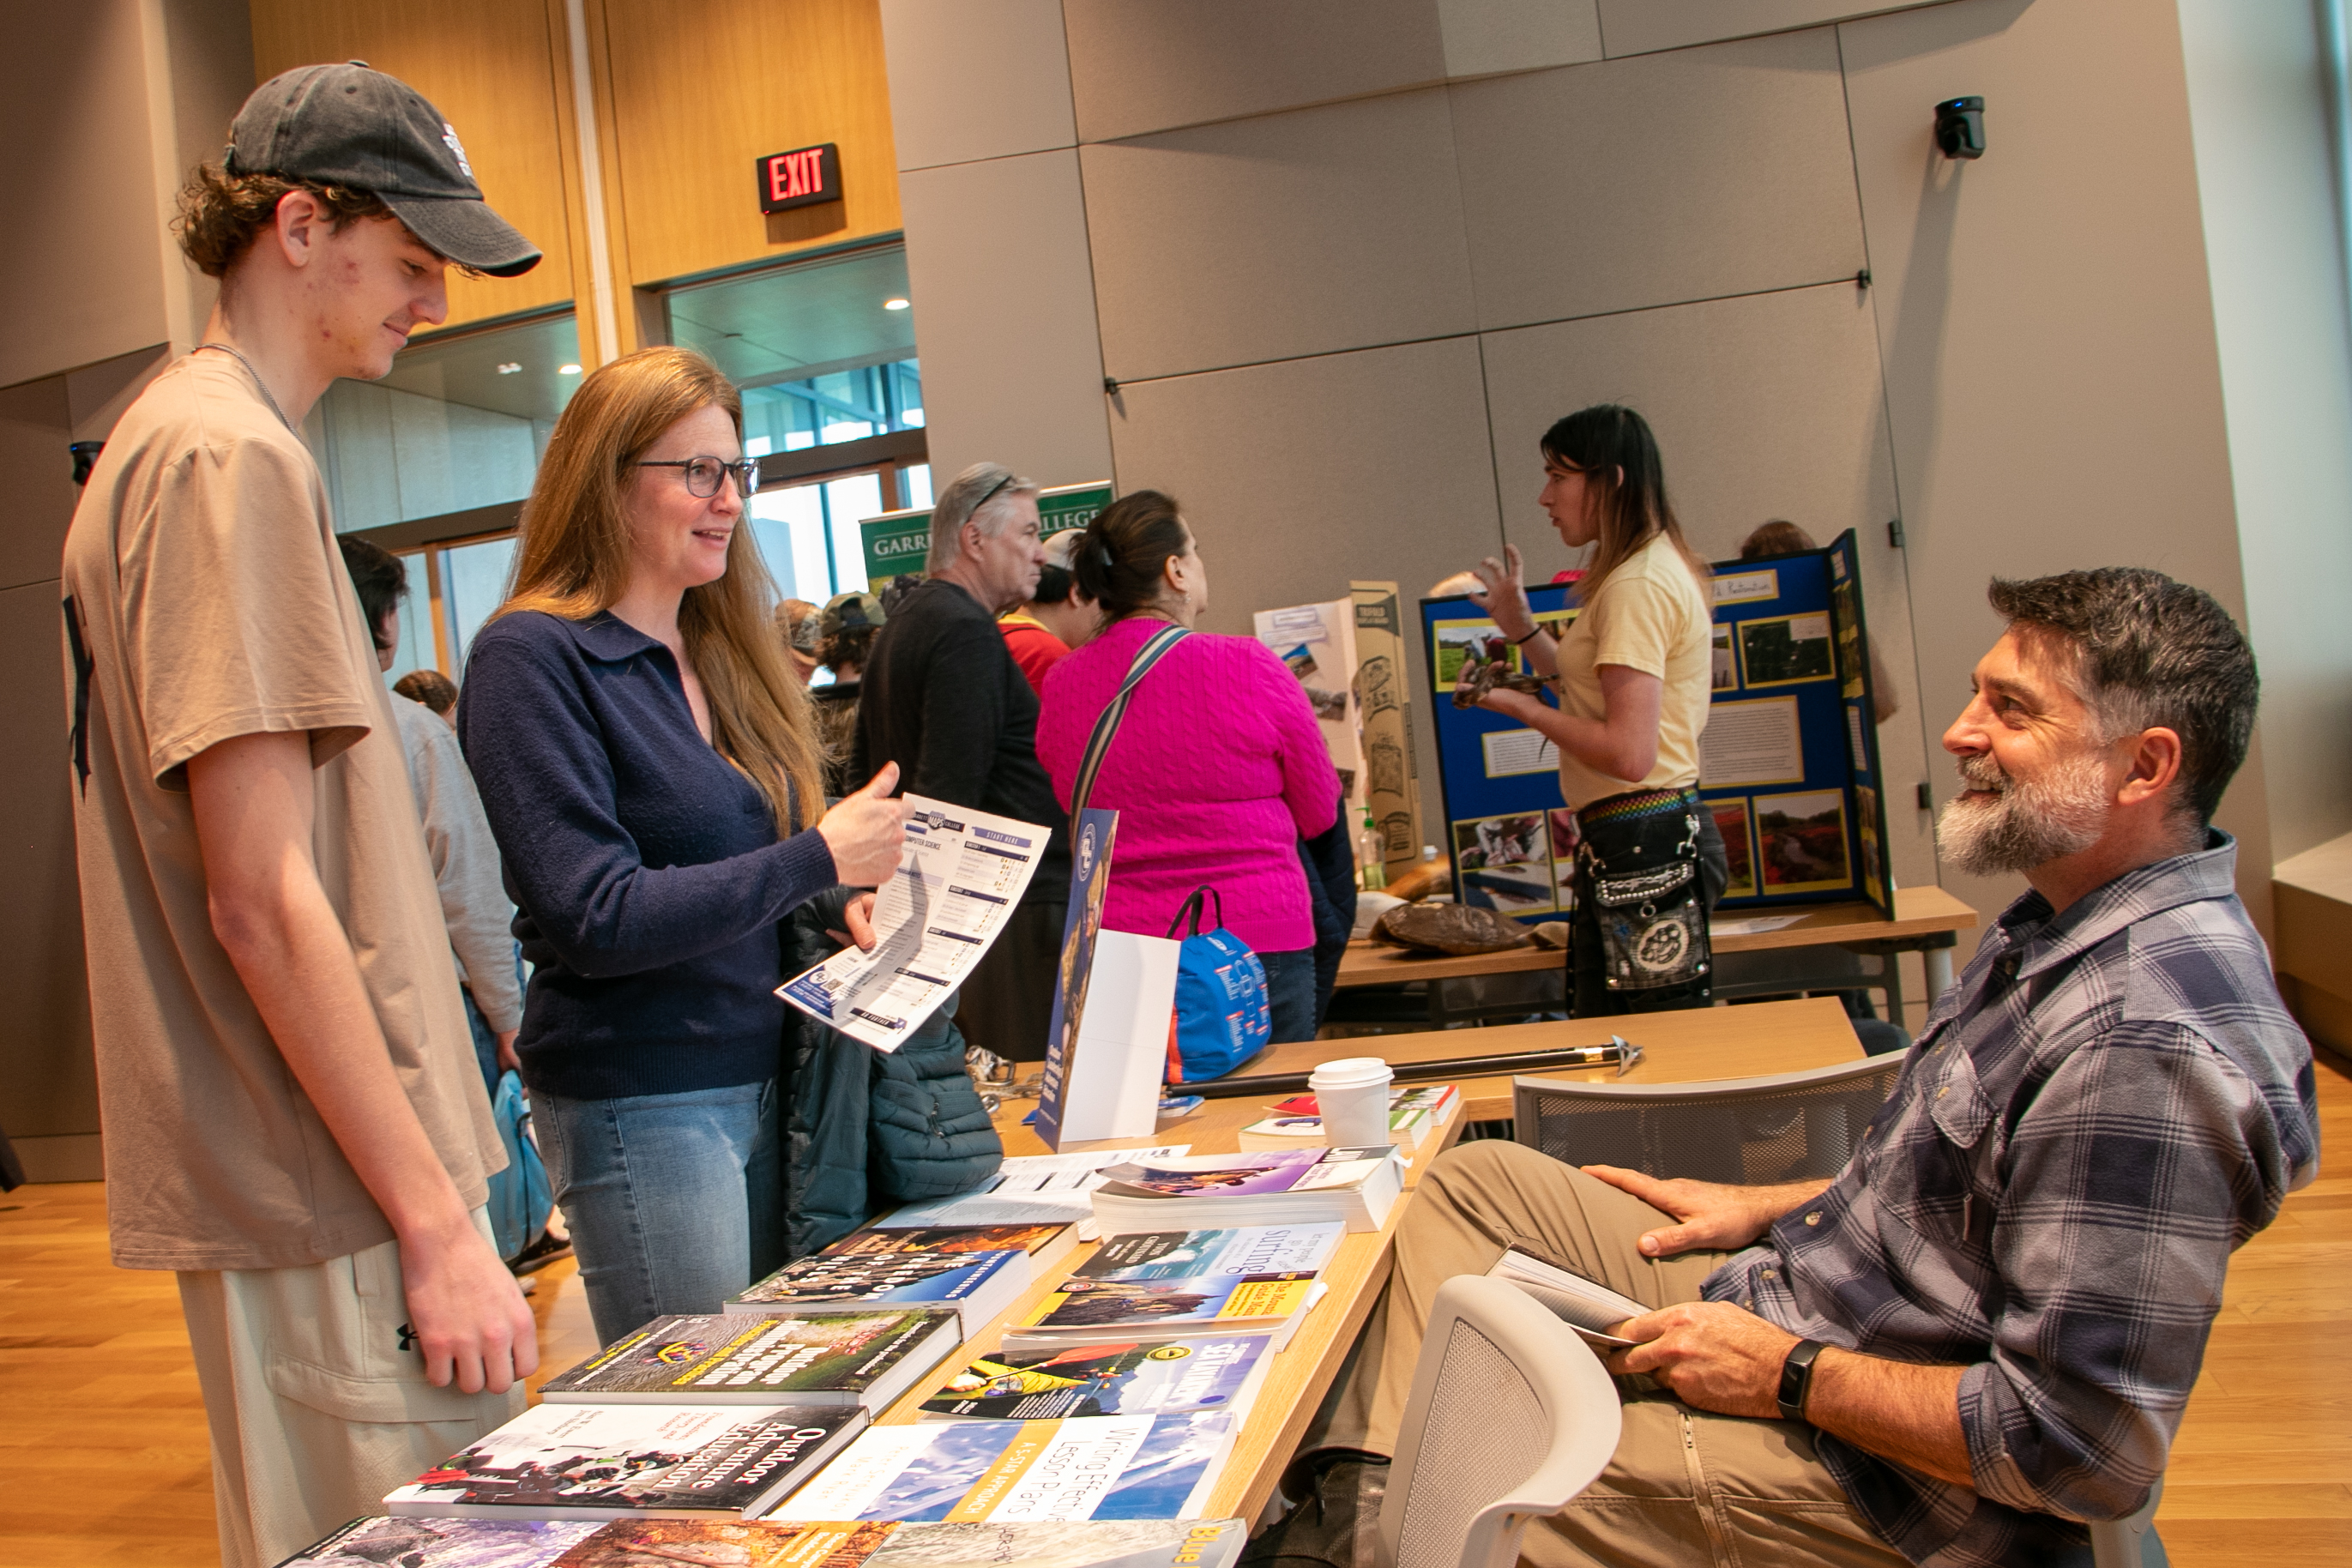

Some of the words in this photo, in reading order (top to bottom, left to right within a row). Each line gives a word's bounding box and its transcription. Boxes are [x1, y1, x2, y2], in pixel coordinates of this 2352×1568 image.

[770, 148, 823, 201] EXIT
[874, 533, 932, 555] GARR
[1041, 509, 1100, 531] LLEG
[905, 835, 925, 845] OMPUTER
[925, 840, 942, 851] SCIENCE
[986, 831, 1003, 841] START
[1004, 835, 1019, 845] HERE
[1322, 1147, 1366, 1163] LAW
[861, 1254, 897, 1266] OF
[939, 1251, 982, 1268] THE
[1146, 1242, 1171, 1255] YVON
[1226, 1229, 1293, 1275] surfing
[1293, 1247, 1317, 1263] people
[795, 1256, 855, 1282] HILLS
[826, 1270, 873, 1290] THE
[855, 1252, 940, 1300] FREEDOM
[941, 1250, 1012, 1298] MOUNTAINEERING
[1251, 1282, 1276, 1300] Guide
[1273, 1282, 1294, 1292] The
[1241, 1300, 1265, 1316] Manu
[1259, 1294, 1287, 1315] Mountai
[725, 1319, 781, 1345] Principles
[691, 1319, 813, 1384] Administration
[710, 1346, 741, 1356] and
[721, 1343, 807, 1384] Program
[1196, 1343, 1235, 1360] SEA
[667, 1357, 727, 1384] Practices
[753, 1347, 833, 1384] Outdoor
[1158, 1360, 1226, 1407] KAYAKER'S
[653, 1412, 691, 1432] Research
[659, 1430, 684, 1439] and
[650, 1421, 769, 1488] Education
[687, 1421, 803, 1488] Adventure
[730, 1427, 831, 1483] Outdoor
[875, 1445, 909, 1465] Peter
[996, 1449, 1032, 1473] 5-STAR
[1034, 1440, 1091, 1478] Lesson
[1073, 1427, 1140, 1470] Writing
[838, 1456, 873, 1477] Mark
[813, 1481, 848, 1499] Ryan
[961, 1475, 1010, 1514] APPROACH
[1004, 1482, 1061, 1513] Plans
[1040, 1474, 1109, 1522] Effective
[783, 1532, 831, 1562] Bouldering
[818, 1532, 848, 1548] Cheat
[1171, 1527, 1224, 1563] Blue
[793, 1549, 829, 1568] Canyo
